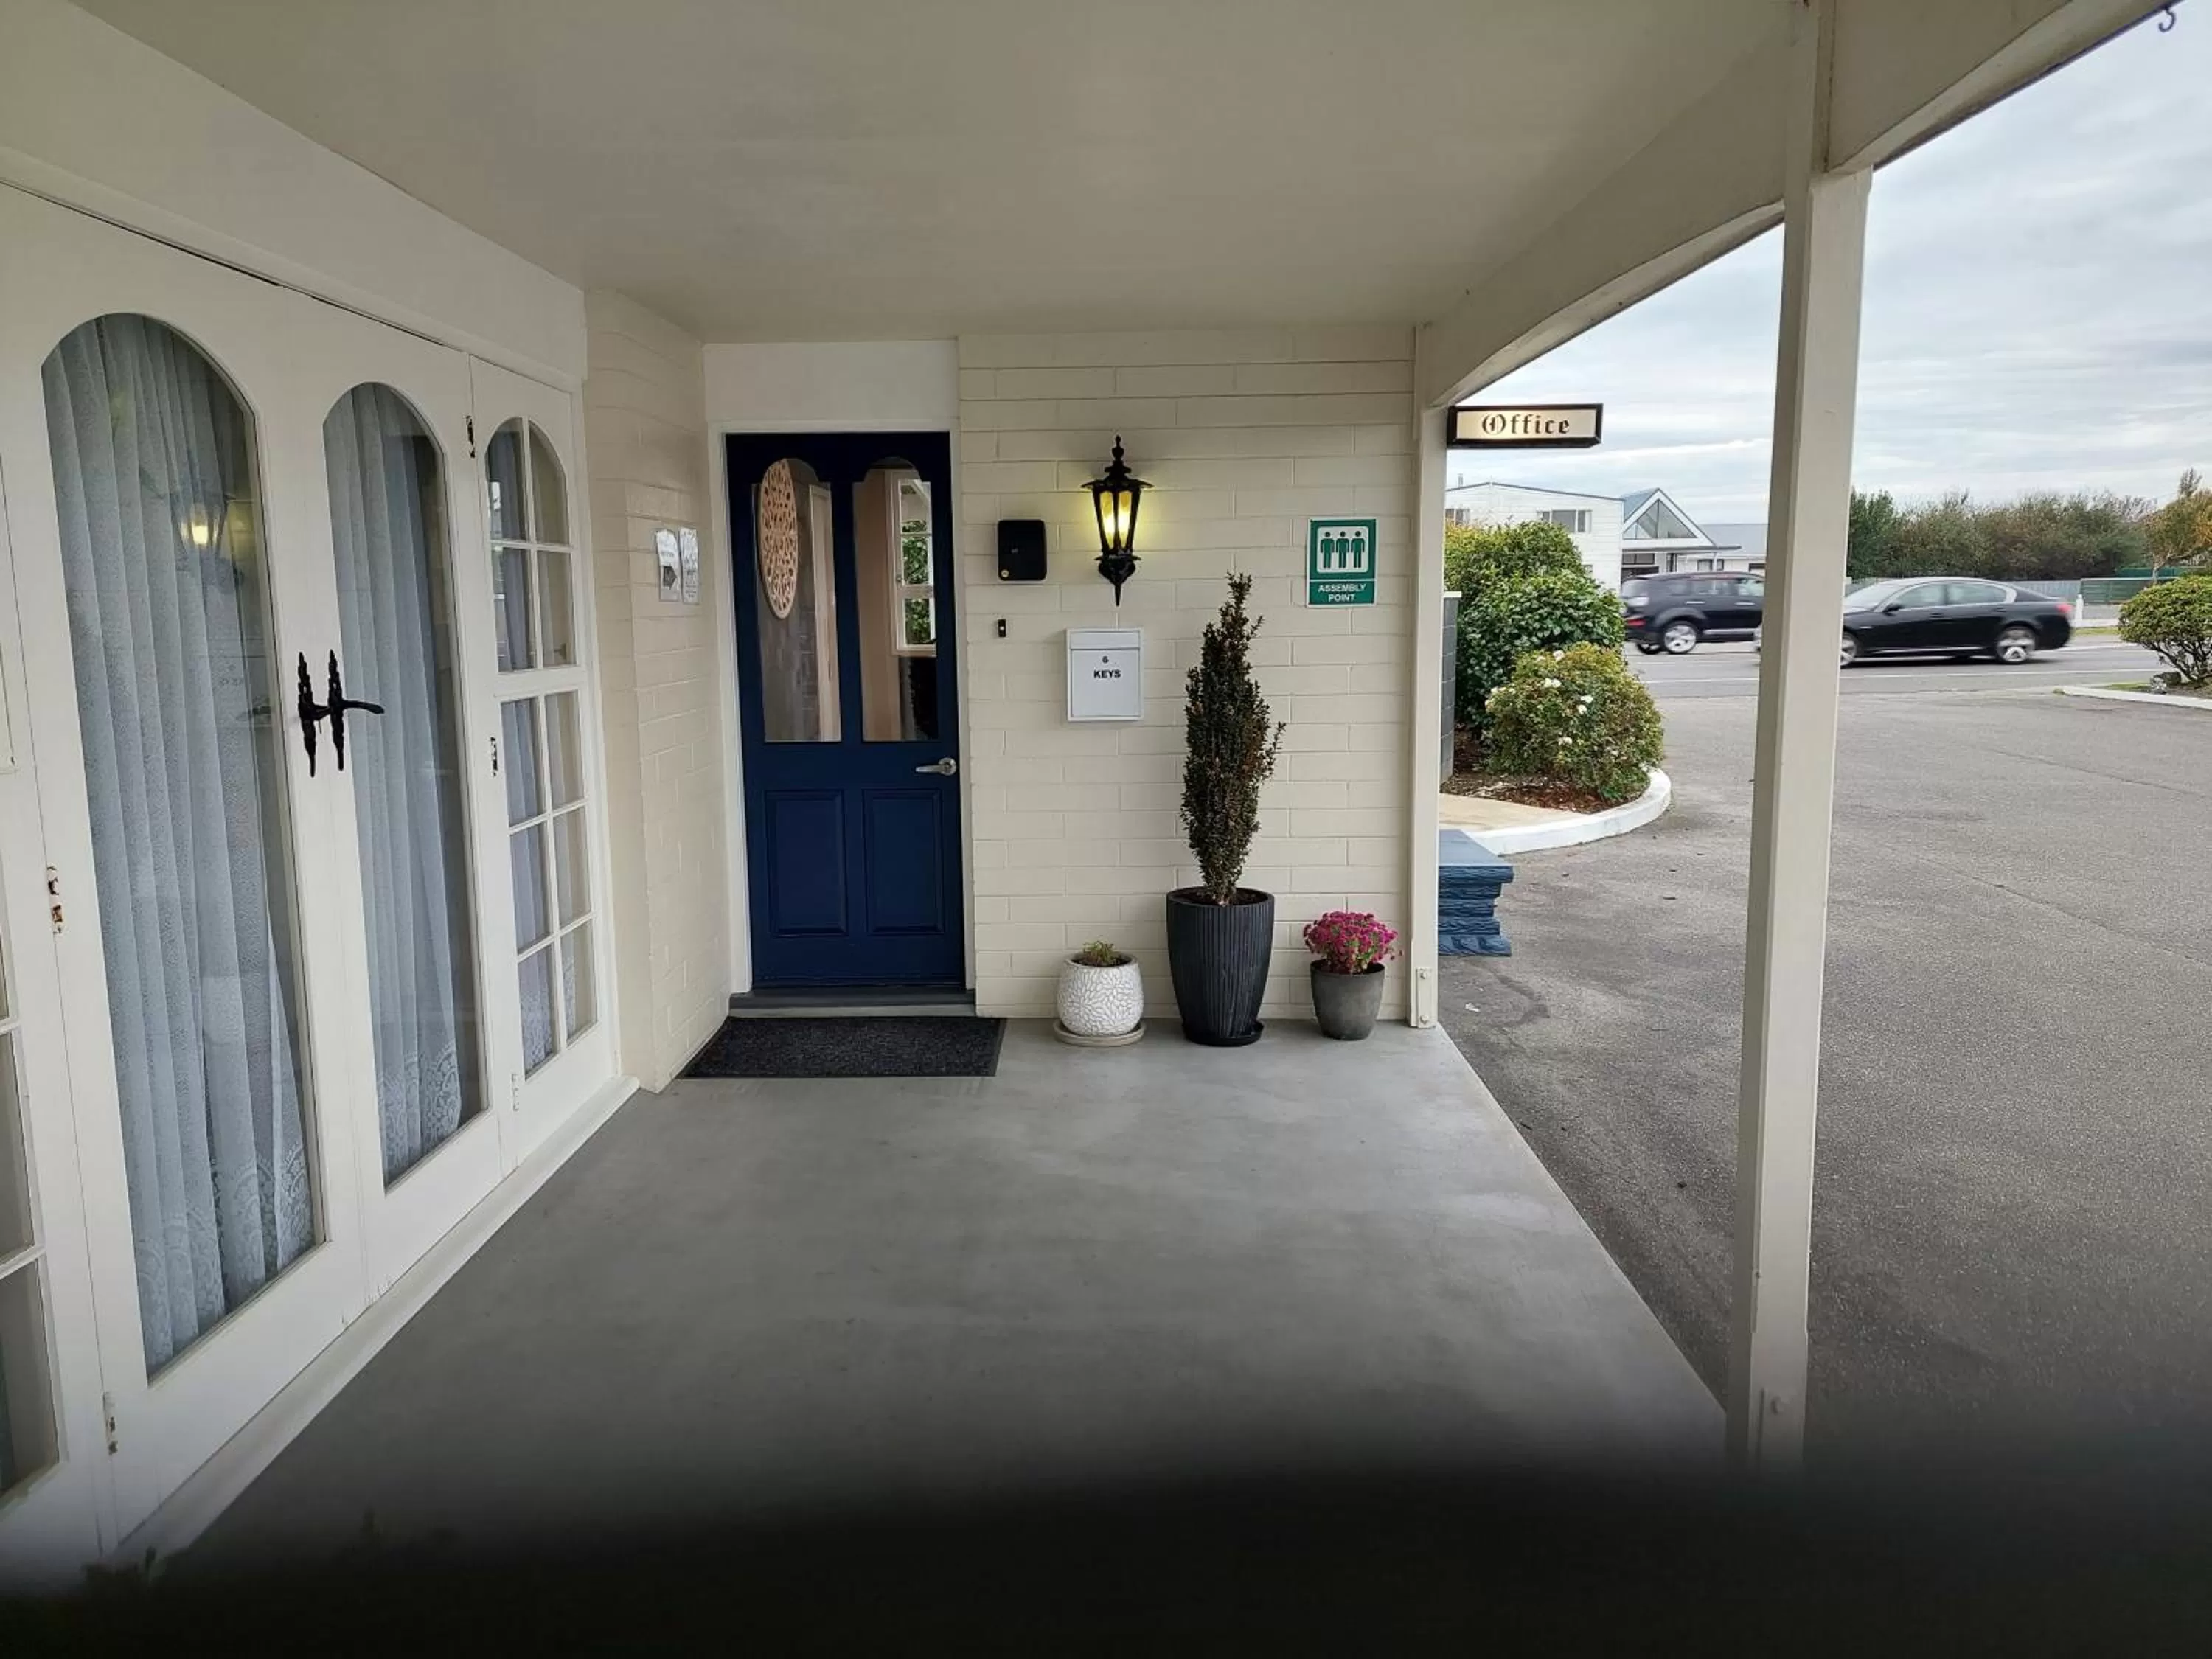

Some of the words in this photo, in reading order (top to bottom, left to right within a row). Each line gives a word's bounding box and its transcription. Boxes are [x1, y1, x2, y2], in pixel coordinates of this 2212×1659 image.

[1482, 414, 1570, 434] Office
[1318, 583, 1366, 593] ASSEMBLY
[1328, 594, 1355, 602] POINT
[1093, 669, 1121, 679] KEYS
